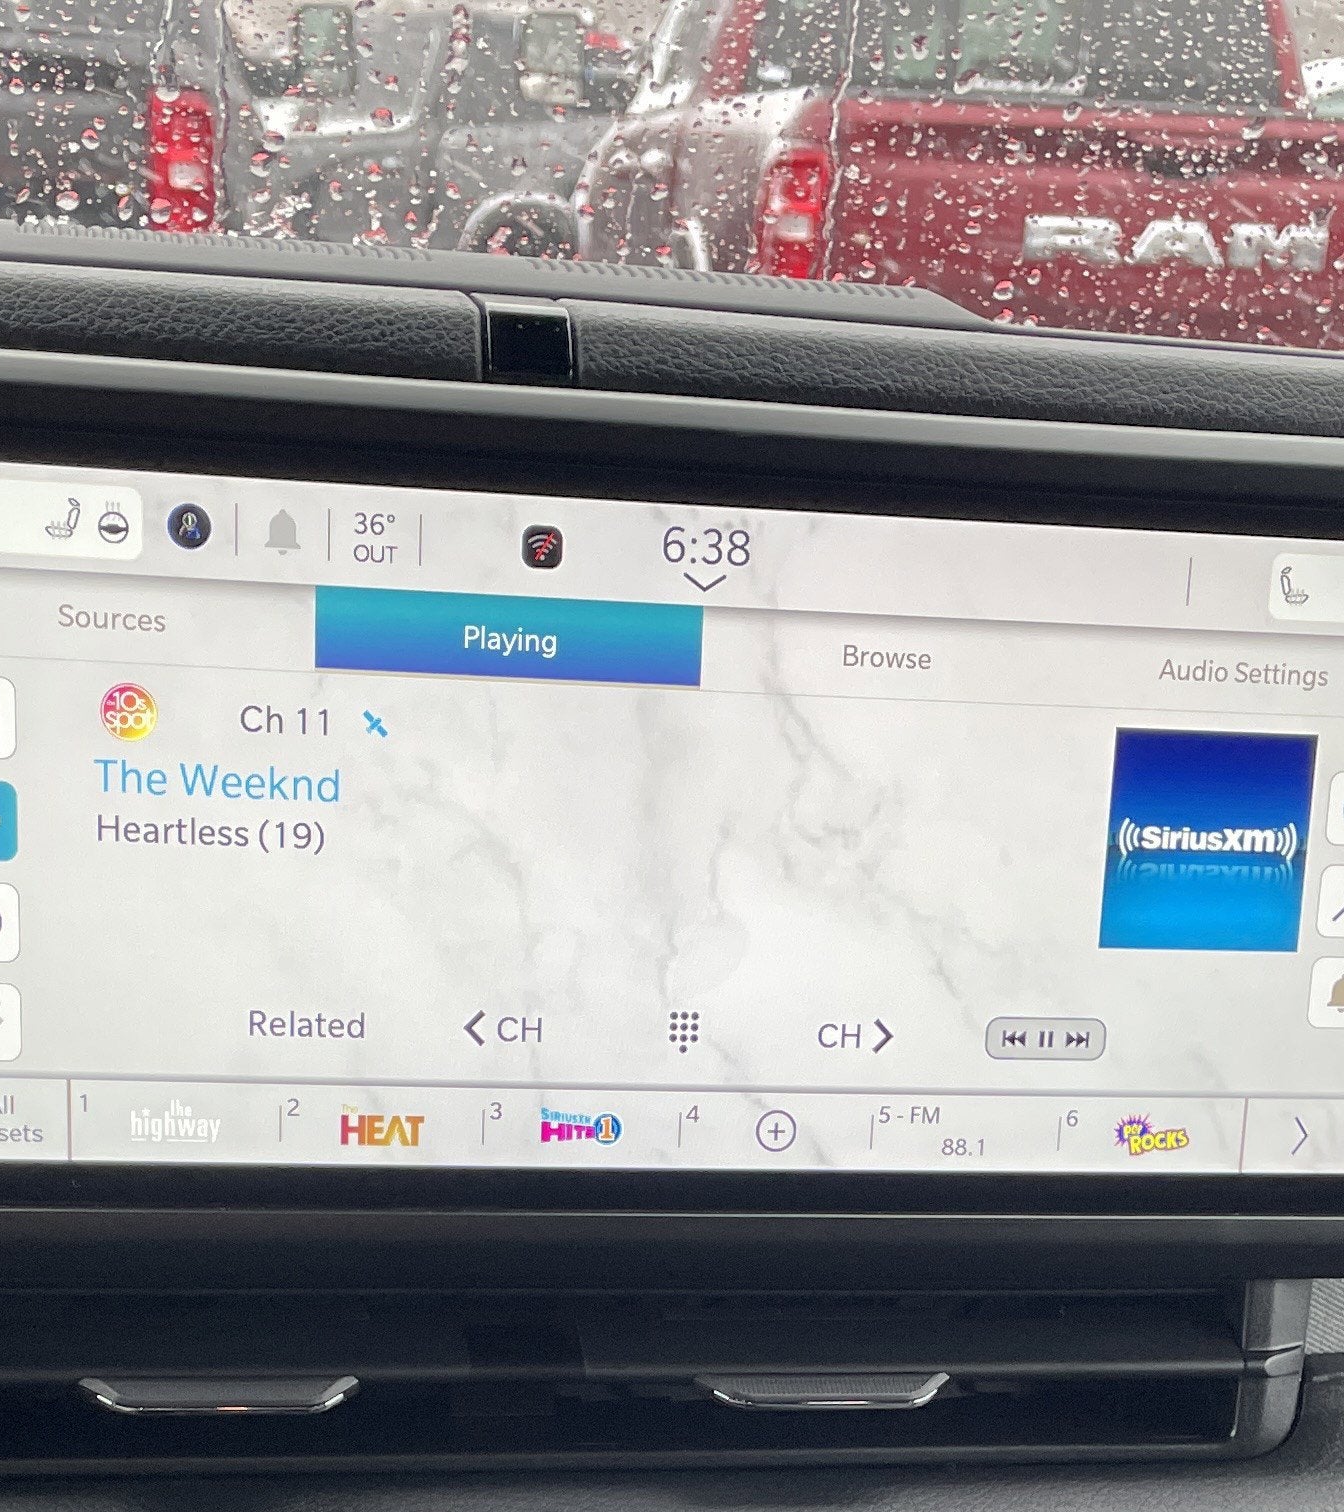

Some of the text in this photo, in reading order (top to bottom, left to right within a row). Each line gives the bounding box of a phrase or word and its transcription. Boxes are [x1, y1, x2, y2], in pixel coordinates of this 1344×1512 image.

[1021, 213, 1328, 270] RAM
[355, 512, 395, 535] 36°
[354, 545, 398, 565] OUT
[663, 526, 750, 568] 6:38
[58, 605, 166, 633] Sources
[464, 626, 558, 659] Playing
[842, 643, 932, 671] Browse
[1158, 658, 1328, 692] Audio Settings
[106, 710, 156, 735] spot
[240, 705, 329, 736] Ch 11
[94, 759, 340, 803] The Weeknd
[96, 815, 325, 855] Heartless (19)
[248, 1010, 366, 1040] Related
[496, 1016, 543, 1043] CH
[817, 1023, 861, 1049] CH
[79, 1093, 88, 1113] 1
[286, 1098, 300, 1117] 2
[489, 1101, 503, 1120] 3
[685, 1106, 700, 1124] 4
[879, 1105, 892, 1125] 5
[910, 1107, 941, 1125] FM
[130, 1110, 221, 1142] highway
[340, 1114, 425, 1146] HEAT
[1066, 1109, 1079, 1128] 6
[941, 1138, 986, 1157] 88.1
[1128, 1129, 1189, 1155] ROCKS
